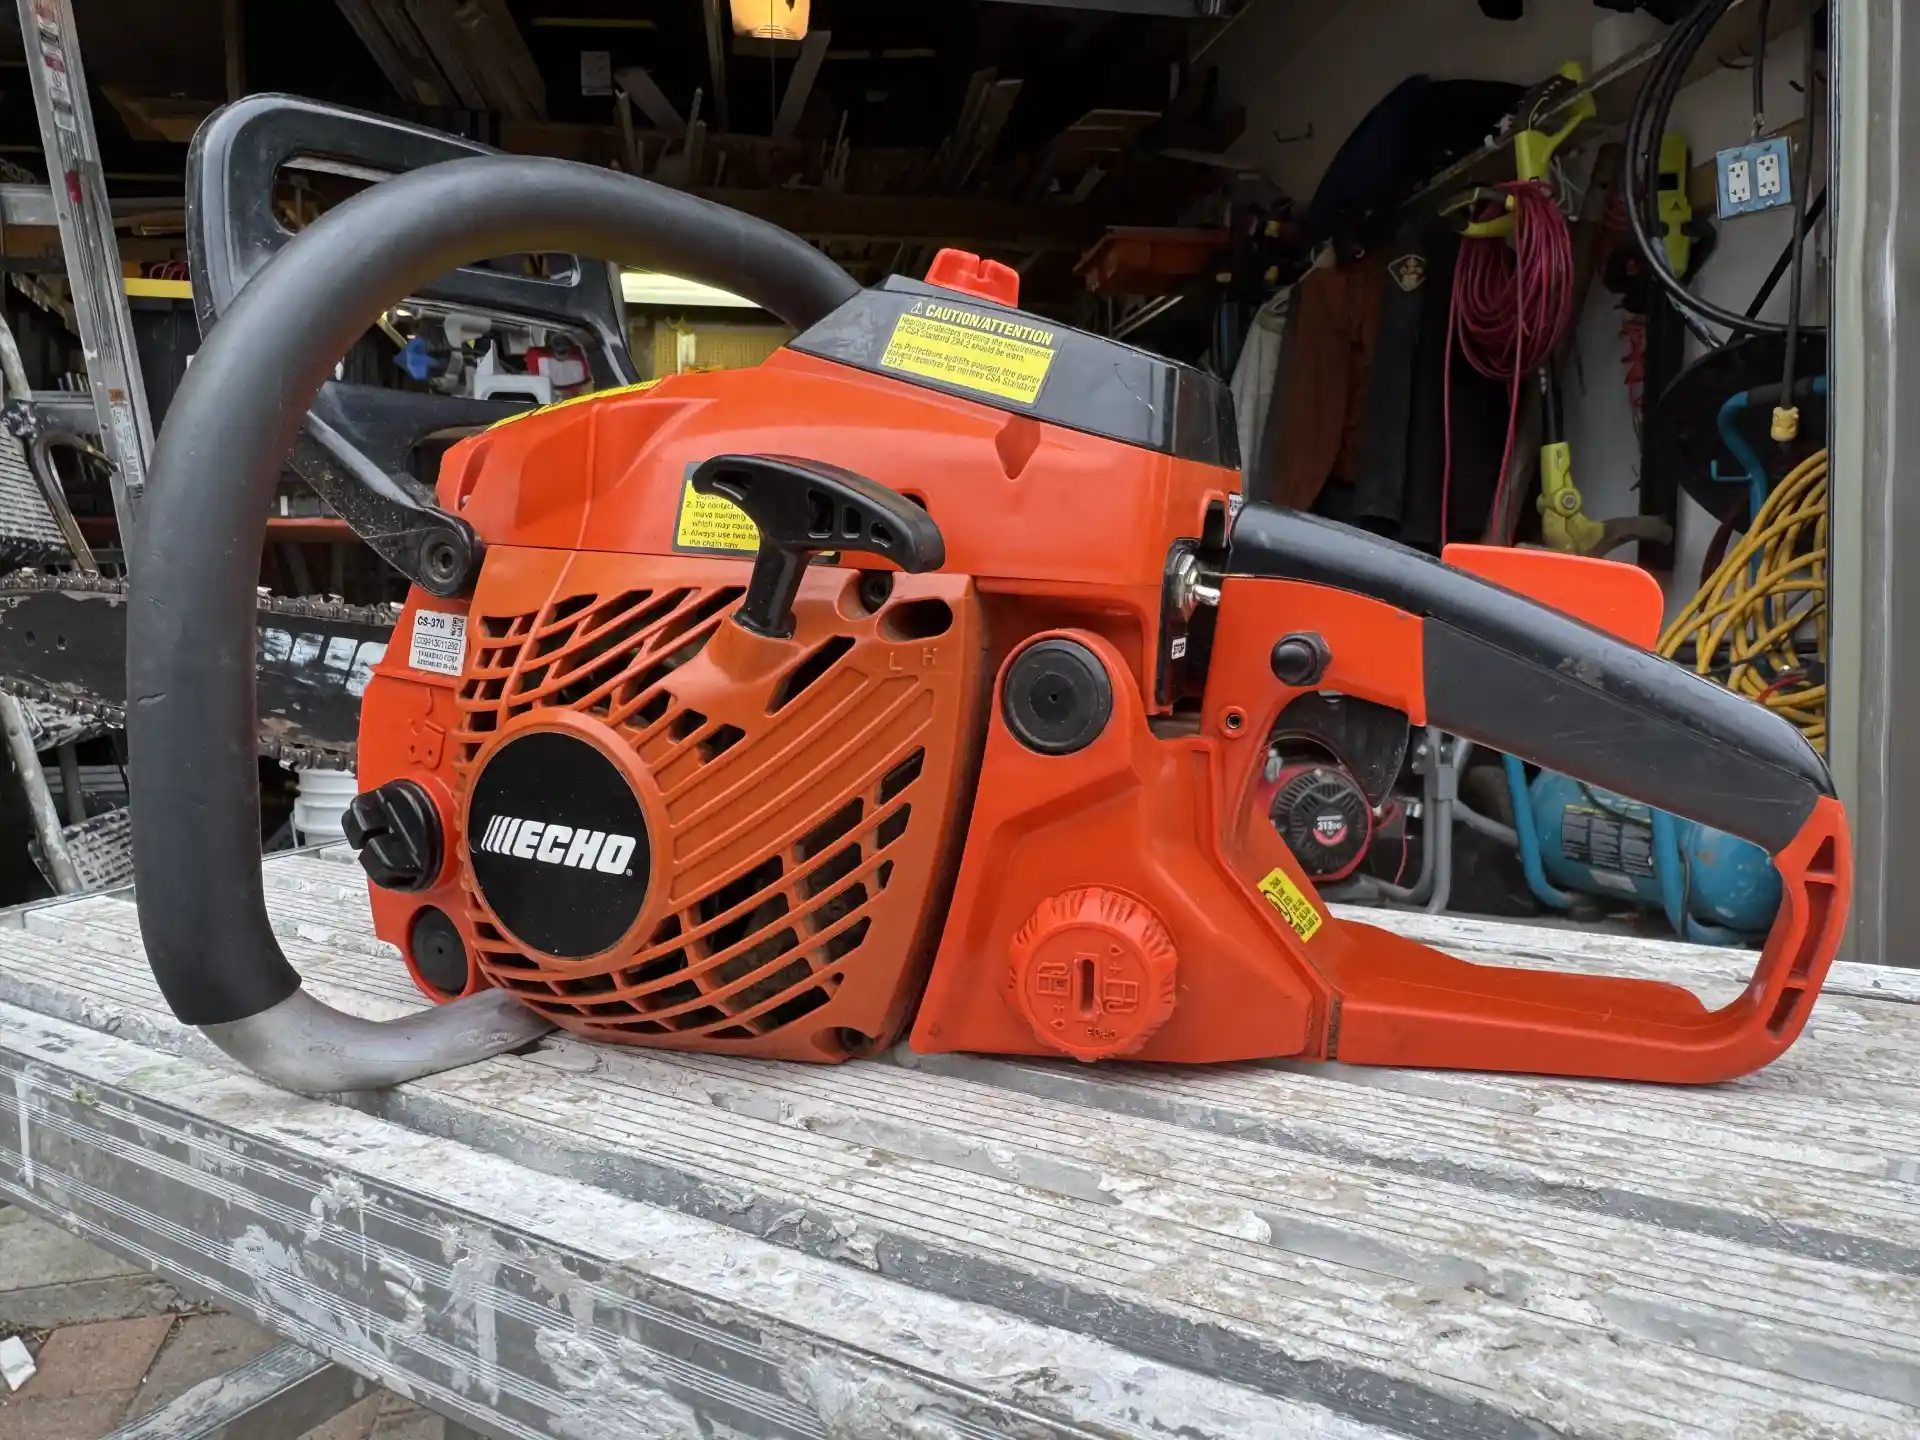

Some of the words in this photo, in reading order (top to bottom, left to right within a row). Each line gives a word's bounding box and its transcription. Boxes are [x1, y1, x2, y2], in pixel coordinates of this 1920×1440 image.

[926, 304, 1054, 346] CAUTION/ATTENTION
[905, 326, 919, 336] CSA
[920, 330, 950, 344] Standard
[950, 336, 970, 348] Z94.2
[971, 339, 995, 354] should
[996, 345, 1005, 356] be
[926, 322, 961, 338] protectors
[1004, 340, 1051, 360] requirements
[904, 343, 942, 361] Protecteurs
[971, 359, 1000, 374] pouvant
[986, 371, 1001, 384] CSA
[1002, 375, 1036, 393] Standard
[690, 530, 716, 539] Always
[732, 532, 746, 540] two
[417, 616, 445, 629] CS-370
[889, 651, 902, 670] L
[921, 647, 937, 667] H
[511, 819, 637, 875] ECHO
